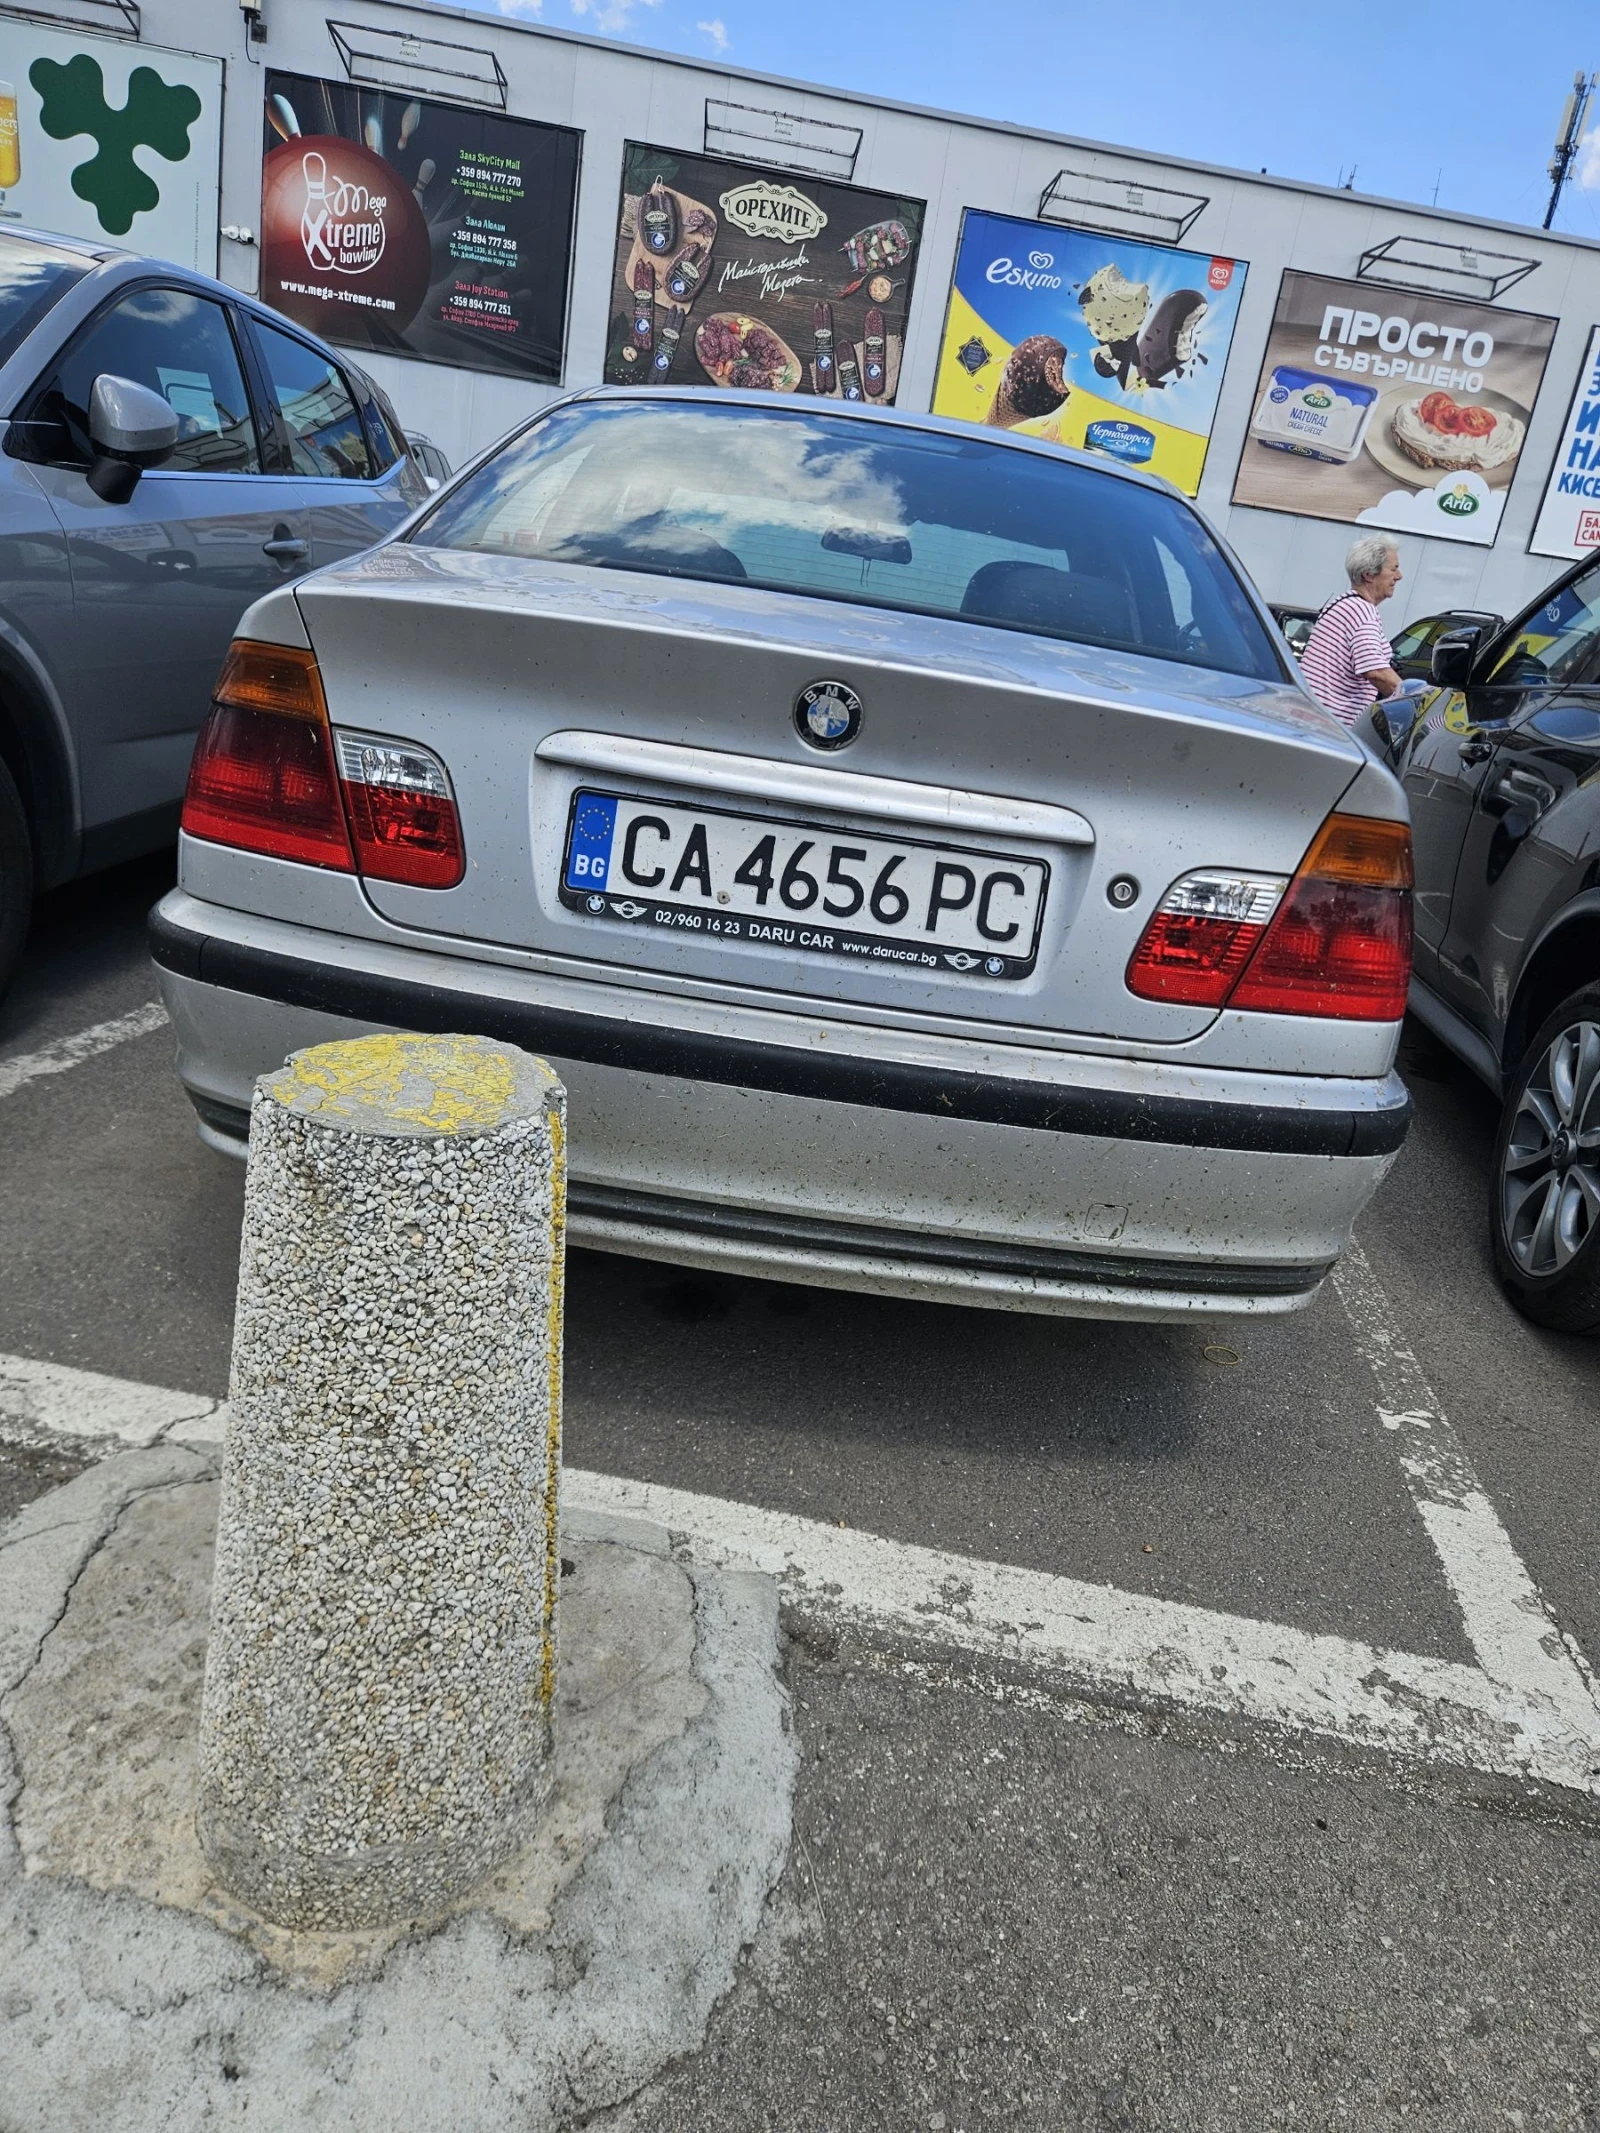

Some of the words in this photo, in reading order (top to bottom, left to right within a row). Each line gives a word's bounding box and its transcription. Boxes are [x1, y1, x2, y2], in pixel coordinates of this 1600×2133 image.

[460, 149, 476, 161] Зала
[478, 153, 504, 169] SkyCity
[456, 166, 475, 178] +359
[476, 169, 491, 181] 894
[492, 172, 506, 184] 777
[507, 175, 521, 187] 270
[332, 175, 387, 217] Mega
[466, 216, 482, 227] Зала
[483, 219, 506, 232] Люлин
[735, 198, 812, 229] ОРЕХИТЕ
[304, 209, 381, 261] Xtreme
[453, 230, 471, 242] +359
[472, 233, 486, 245] 894
[488, 236, 502, 248] 777
[503, 239, 517, 251] 358
[340, 246, 377, 264] bowling
[986, 257, 1061, 290] eskimo
[281, 280, 396, 310] www.mega-xtreme.com
[455, 280, 471, 292] Зала
[472, 284, 482, 295] Joy
[483, 286, 508, 299] Station
[449, 296, 468, 307] +359
[469, 298, 483, 310] 894
[484, 301, 498, 312] 777
[498, 304, 511, 316] 251
[1319, 305, 1494, 368] ПРОСТО
[1314, 345, 1484, 394] СЪВЪРШЕНО
[1305, 396, 1328, 406] Arla
[1290, 407, 1329, 428] NATURAL
[1092, 424, 1151, 446] Черноморец
[1442, 495, 1473, 512] Arla
[803, 685, 859, 711] BMW
[574, 853, 606, 878] BG
[622, 815, 712, 898] CA
[733, 834, 910, 925] 4656
[925, 861, 1025, 943] PC
[655, 910, 701, 928] 02/960
[706, 918, 721, 932] 16
[724, 921, 740, 934] 23
[748, 923, 795, 944] DARU
[799, 931, 834, 949] CAR
[842, 940, 937, 966] www.darucar.bg
